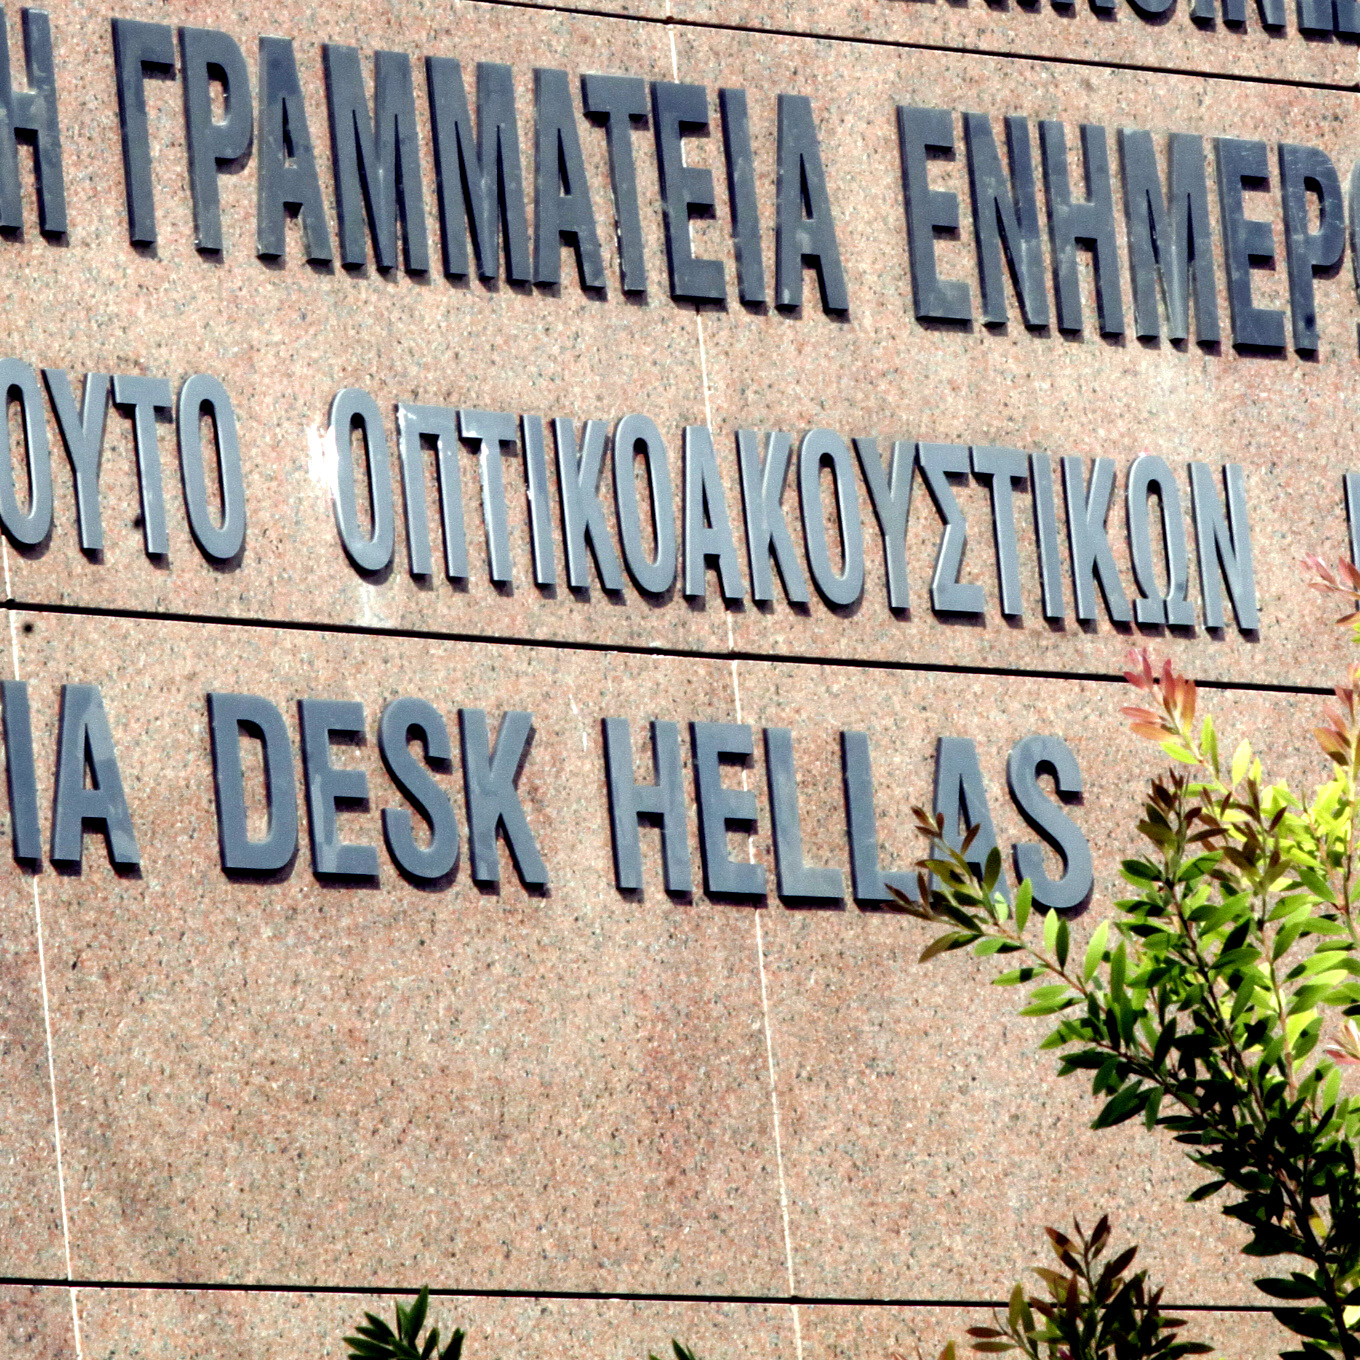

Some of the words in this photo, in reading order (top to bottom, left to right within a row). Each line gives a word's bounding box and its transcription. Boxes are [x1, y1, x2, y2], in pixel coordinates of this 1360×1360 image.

[112, 17, 847, 320] ΓΡΑΜΜΑΤΕΙΑ
[329, 387, 1260, 633] ΟΠΤΙΚΟΑΚΟΥΣΤΙΚΩΝ
[207, 693, 548, 887] DESK
[602, 716, 1094, 909] HELLAS
